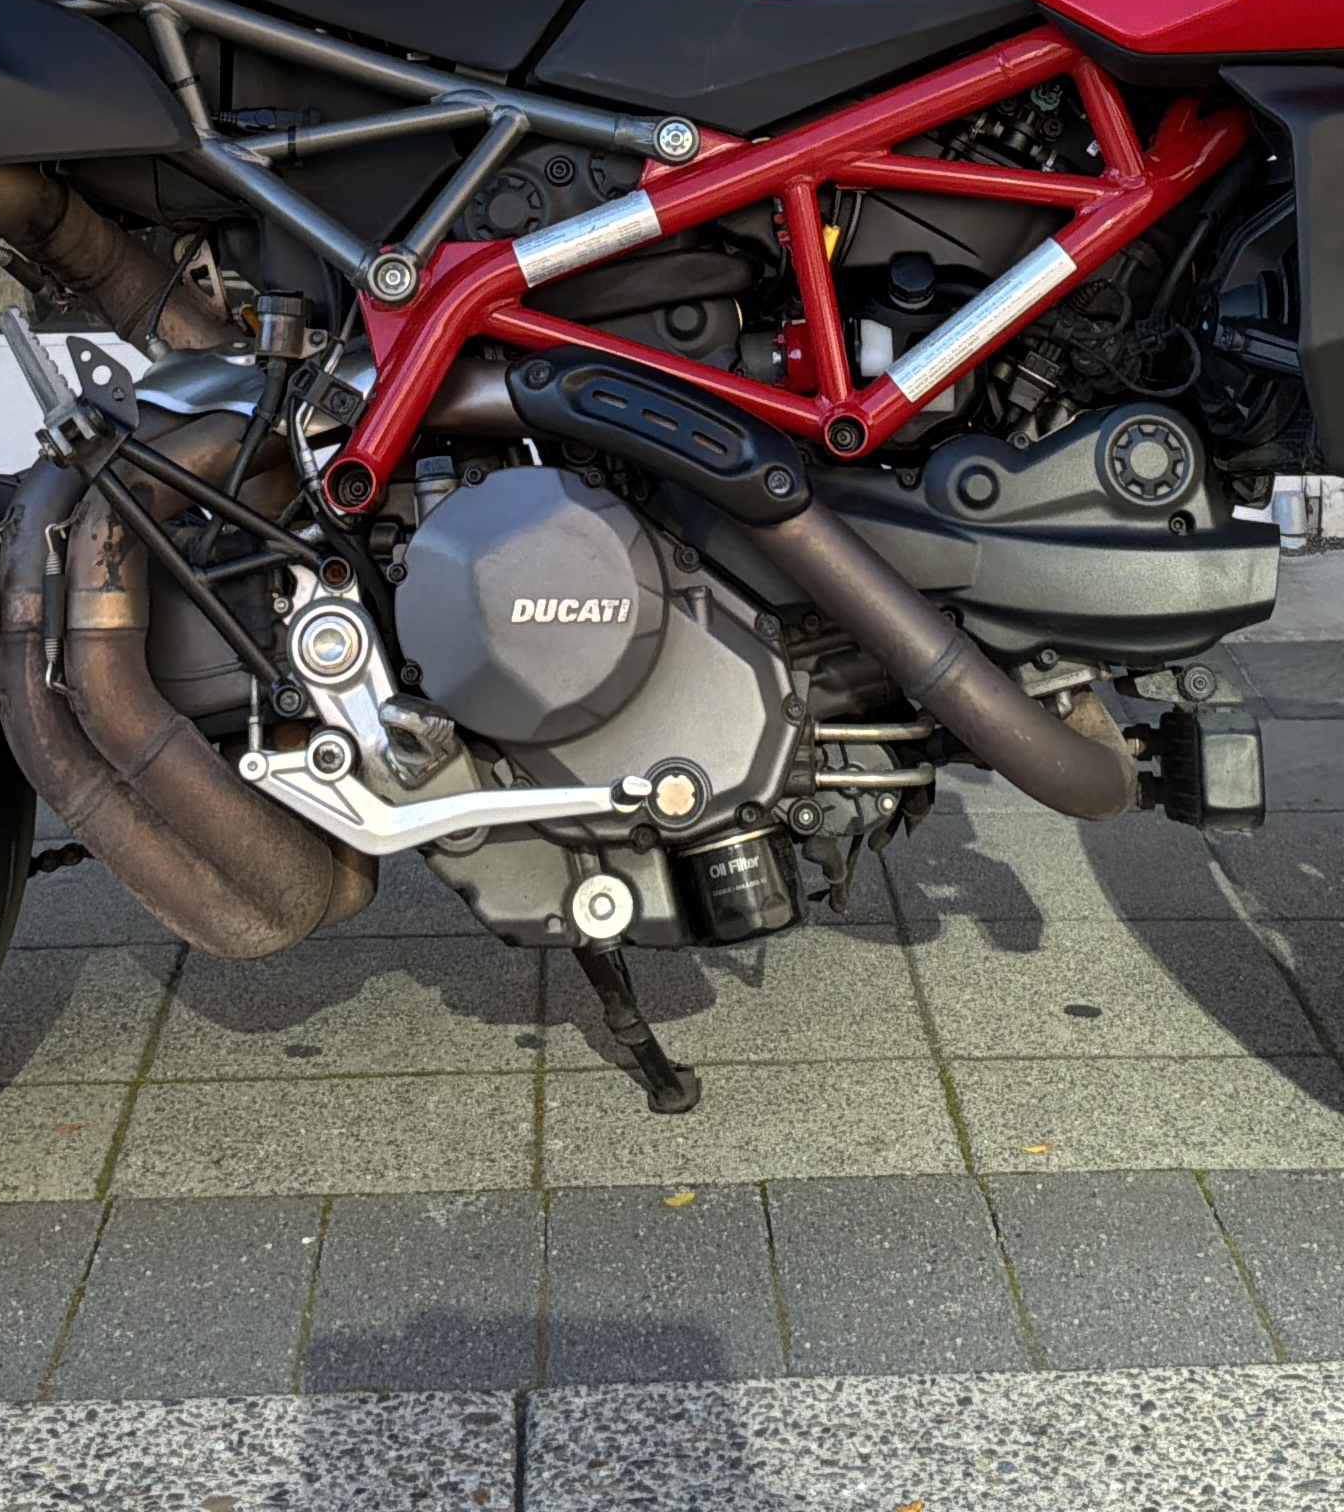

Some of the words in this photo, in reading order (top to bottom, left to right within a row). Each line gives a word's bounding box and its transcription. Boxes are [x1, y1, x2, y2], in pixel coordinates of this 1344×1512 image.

[511, 598, 631, 624] DUCATI
[709, 862, 726, 879] Oil
[728, 855, 760, 874] Filter
